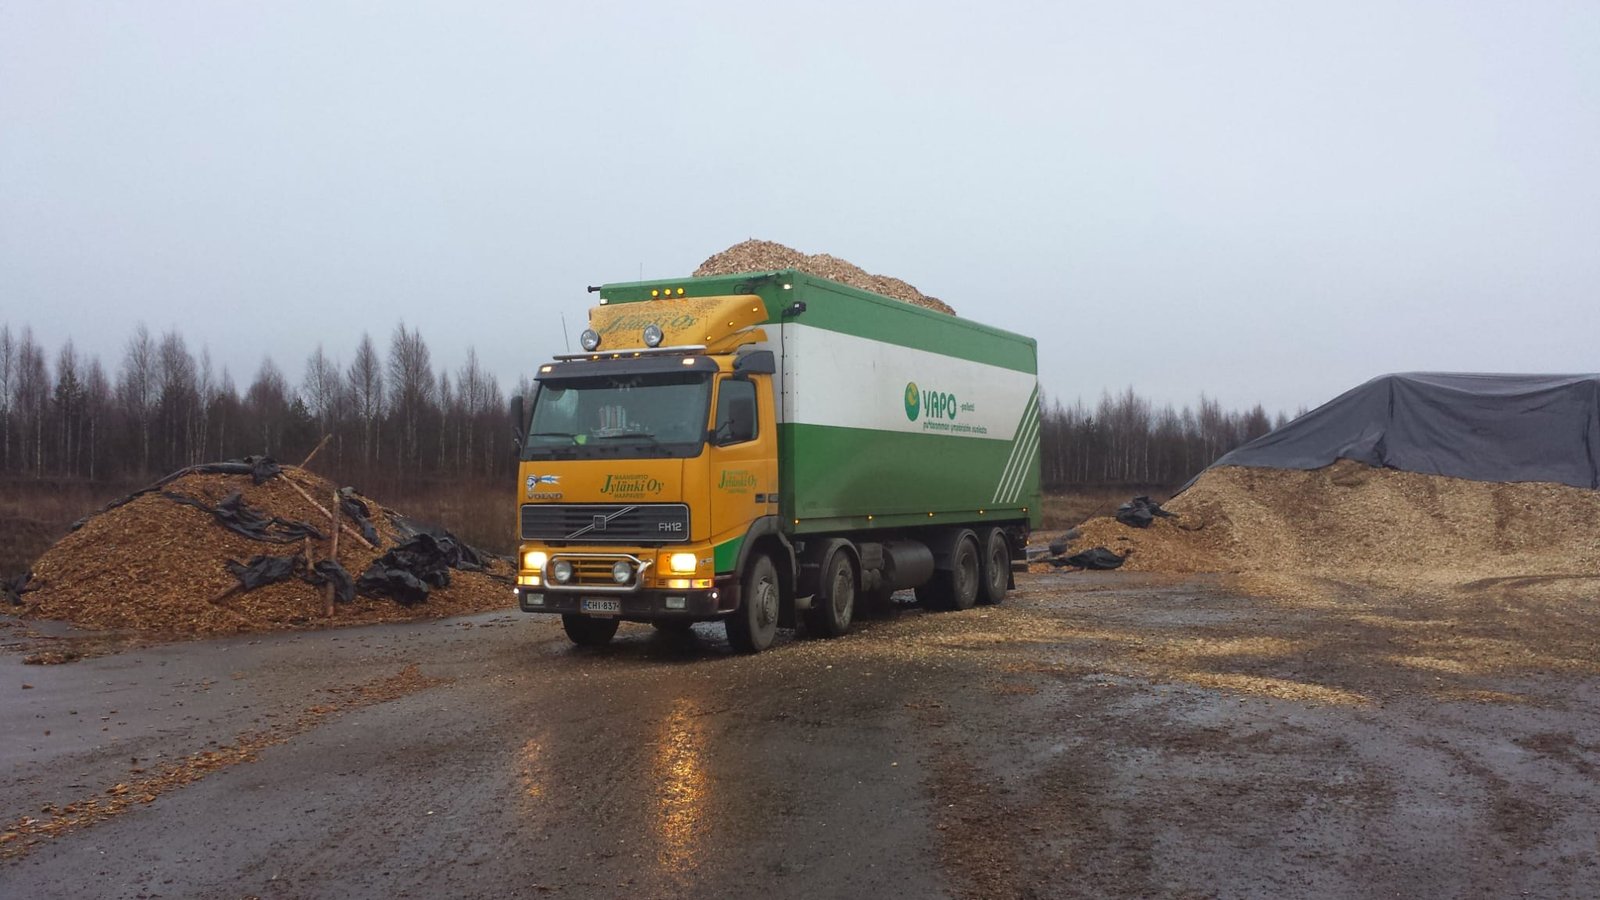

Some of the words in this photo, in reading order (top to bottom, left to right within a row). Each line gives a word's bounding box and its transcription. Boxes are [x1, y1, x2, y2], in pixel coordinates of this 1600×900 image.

[922, 390, 957, 420] VAPO
[600, 474, 645, 495] Jylänki
[646, 479, 665, 495] Oy
[658, 522, 682, 532] FH12
[587, 601, 617, 611] CHI-837
